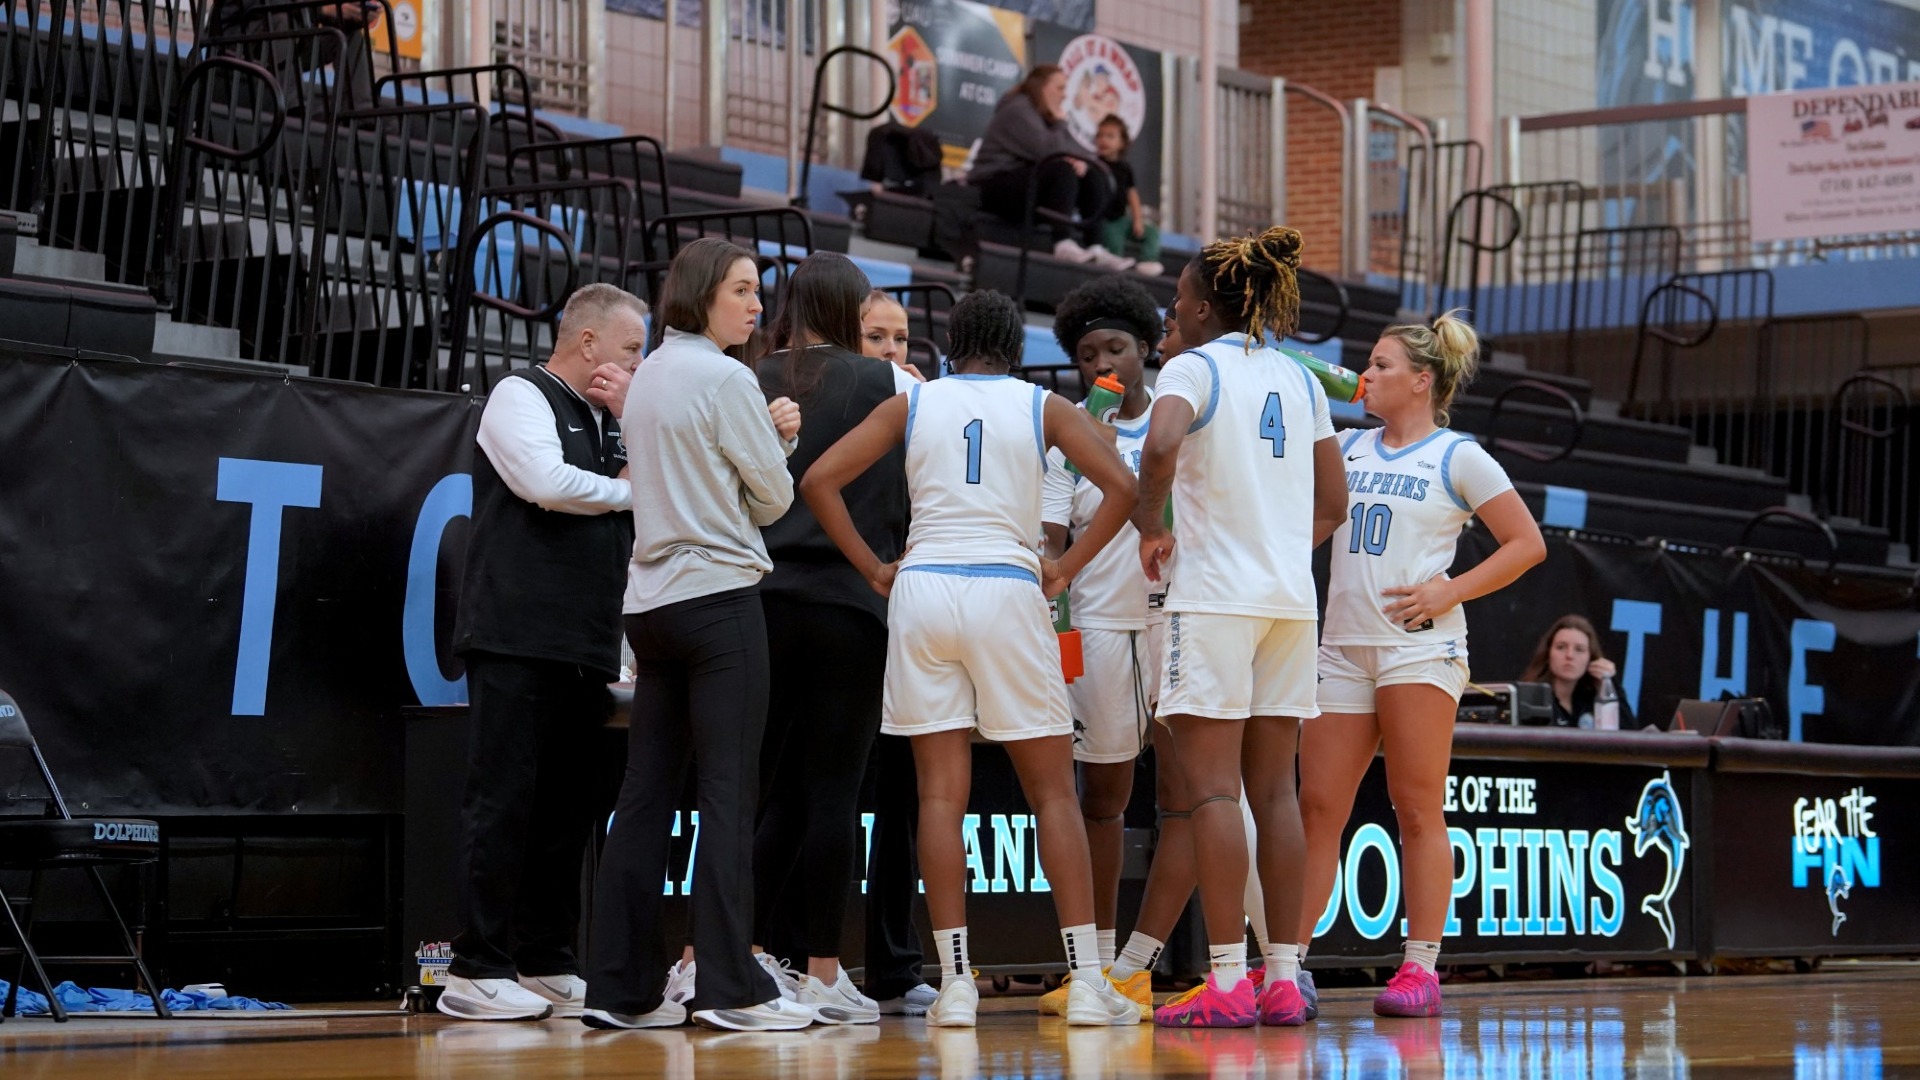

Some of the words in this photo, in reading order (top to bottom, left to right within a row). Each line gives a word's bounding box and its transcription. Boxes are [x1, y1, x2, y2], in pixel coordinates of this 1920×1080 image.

[1643, 0, 1812, 96] HME
[963, 418, 983, 484] 1
[1260, 391, 1286, 458] 4
[1346, 470, 1430, 502] OLPHINS
[1349, 502, 1393, 556] 10
[1461, 776, 1493, 813] OF
[1495, 777, 1537, 814] THE
[1793, 796, 1844, 853] FEAR
[1839, 785, 1877, 838] THE
[94, 822, 159, 843] DOLPHINS
[1792, 835, 1880, 888] FIN
[1311, 822, 1625, 938] OPHINS
